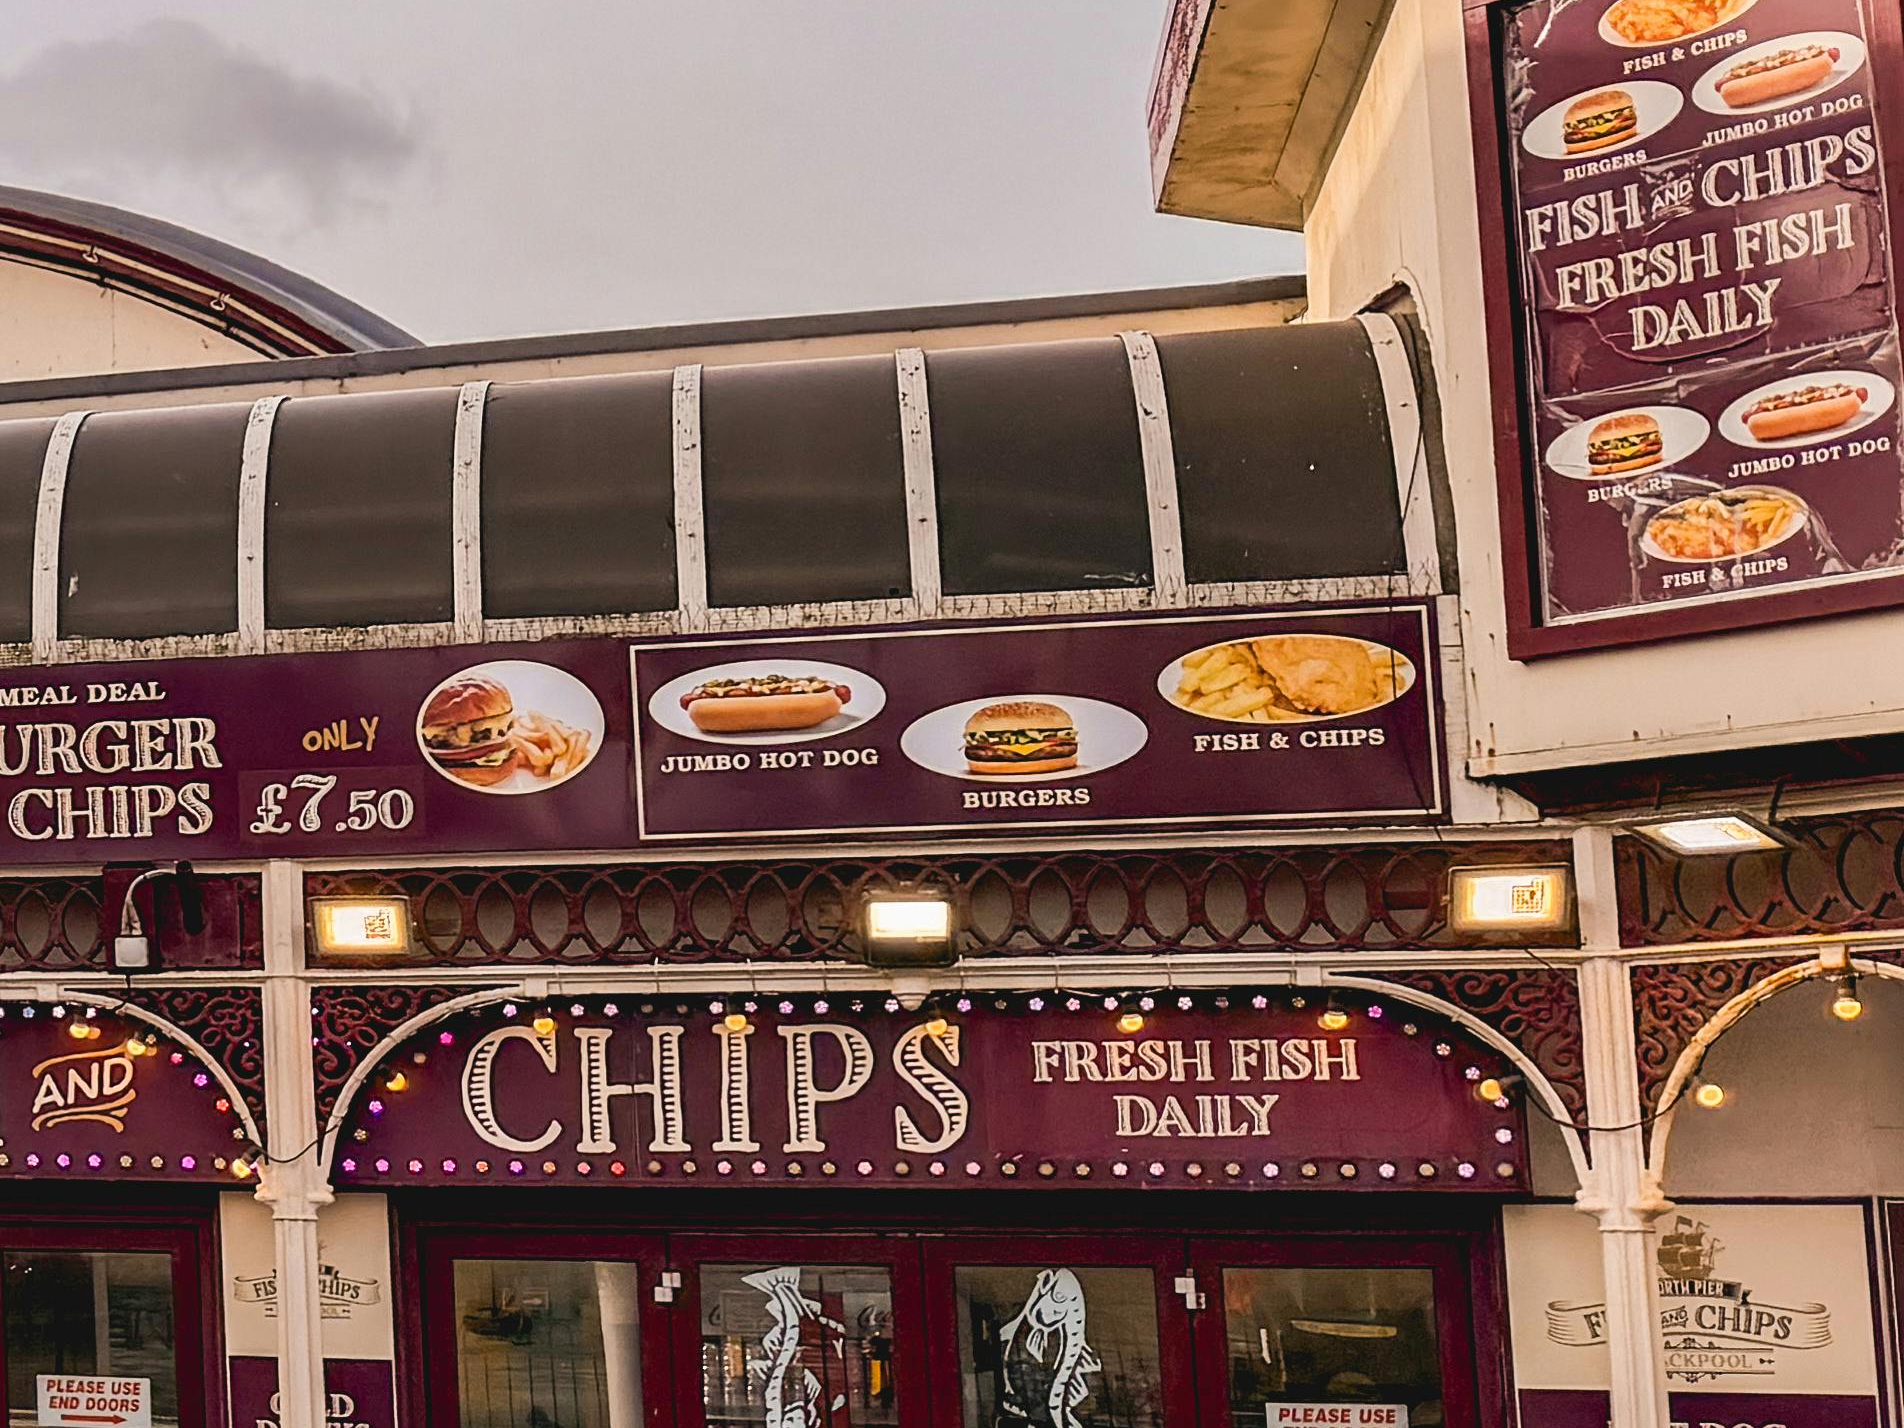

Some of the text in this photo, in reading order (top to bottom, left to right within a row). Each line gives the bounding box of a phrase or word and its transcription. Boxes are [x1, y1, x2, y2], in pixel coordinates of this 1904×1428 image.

[1623, 29, 1748, 74] FISH & CHIPS
[1702, 94, 1864, 147] JUMBO HOT DOG
[1563, 149, 1647, 183] BURGERS
[1525, 125, 1876, 253] FISH AND CHIPS
[1555, 203, 1855, 310] FRESH FISH
[1630, 278, 1782, 351] DAILY
[1727, 437, 1890, 478] JUMBO HOT DOG
[1587, 477, 1673, 503] BURGERS
[1662, 556, 1788, 588] FISH & CHIPS
[87, 680, 166, 703] DEAL
[302, 715, 380, 753] ONLY
[1194, 728, 1385, 754] FISH & CHIPS
[660, 746, 879, 775] JUMBO HOT DOG
[7, 783, 214, 841] CHIPS
[249, 773, 414, 834] £7.50
[962, 788, 1091, 809] BURGERS
[1031, 1038, 1360, 1082] FRESH FISH
[34, 1056, 134, 1114] AND
[460, 1024, 969, 1153] CHIPS
[1113, 1094, 1280, 1137] DAILY
[253, 1280, 360, 1299] FIS HIPS
[1659, 1279, 1724, 1297] ORTH PIER
[1694, 1304, 1792, 1340] CHIPS
[1669, 1353, 1752, 1369] CKPOOL
[46, 1379, 141, 1396] PLEASE USE
[48, 1396, 140, 1412] END DOORS
[1278, 1408, 1396, 1424] PLEASE USE
